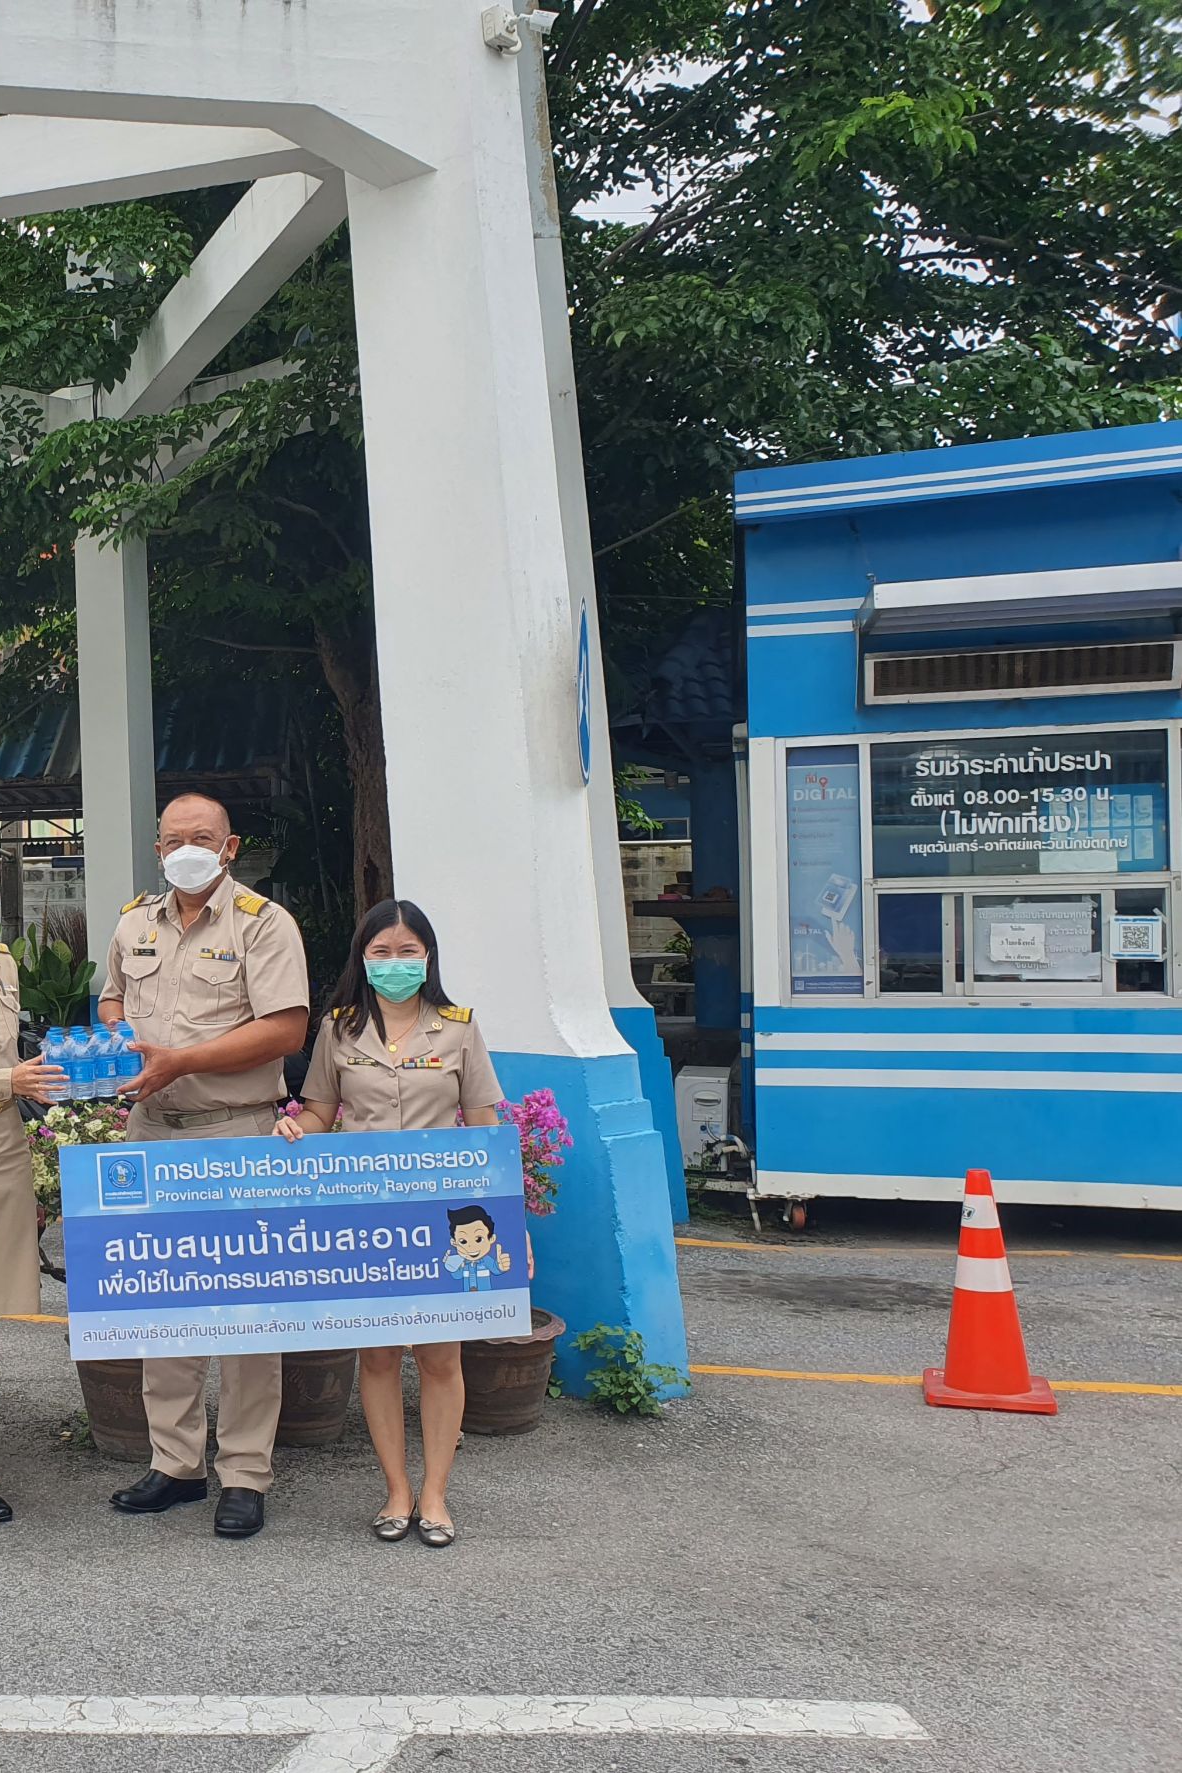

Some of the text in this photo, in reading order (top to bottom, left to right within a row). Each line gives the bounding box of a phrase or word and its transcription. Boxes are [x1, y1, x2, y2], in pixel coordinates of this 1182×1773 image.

[915, 747, 1112, 777] รับชำระค่าน้ำประปา
[911, 786, 1115, 807] ตั้งแต่ 08.00-15.30 น.
[909, 835, 1128, 857] หยุดวันเสาร์-อาทิตย์และวันนักขัตฤกษ์
[154, 1150, 488, 1182] การประปาส่วนภูมิภาคสาขาระยอง
[155, 1187, 224, 1202] Provincial
[229, 1184, 312, 1199] Waterworks
[318, 1181, 380, 1196] Authority
[385, 1178, 438, 1193] Rayong
[442, 1175, 490, 1189] Branch
[105, 1219, 432, 1265] สนับสนุนน้ำดื่มสะอาด
[98, 1257, 440, 1296] เพื่อใช้ในกิจกรรมสาธารณประโยชน์
[83, 1304, 516, 1343] สานสัมพันธ์อันดีกับชุมชนและสังคม พร้อมร่วมสร้างสังคมน่าอยู่ต่อไป
